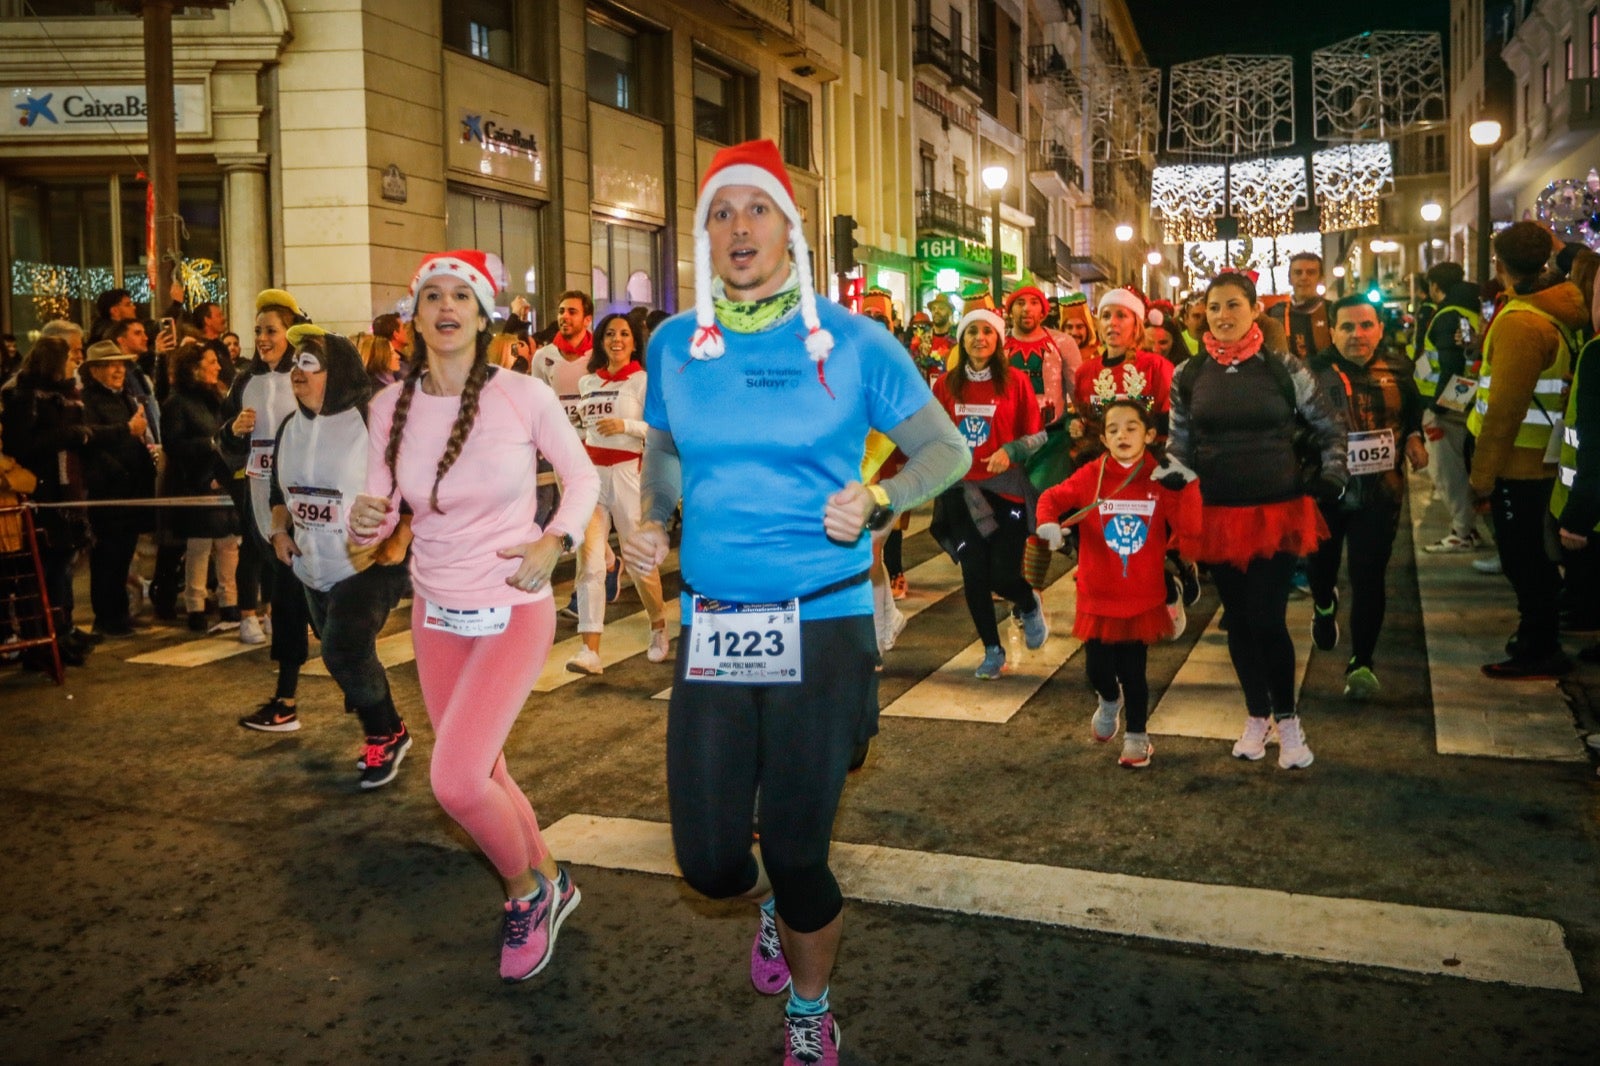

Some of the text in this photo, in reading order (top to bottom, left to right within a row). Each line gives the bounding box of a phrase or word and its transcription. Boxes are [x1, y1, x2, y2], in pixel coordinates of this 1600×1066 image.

[63, 96, 178, 118] CaixaBa
[920, 239, 956, 258] 16H
[580, 402, 613, 416] 1216
[260, 454, 273, 469] 6
[1348, 446, 1390, 463] 1052
[297, 502, 332, 522] 594
[1103, 502, 1114, 511] 30
[708, 630, 785, 657] 1223
